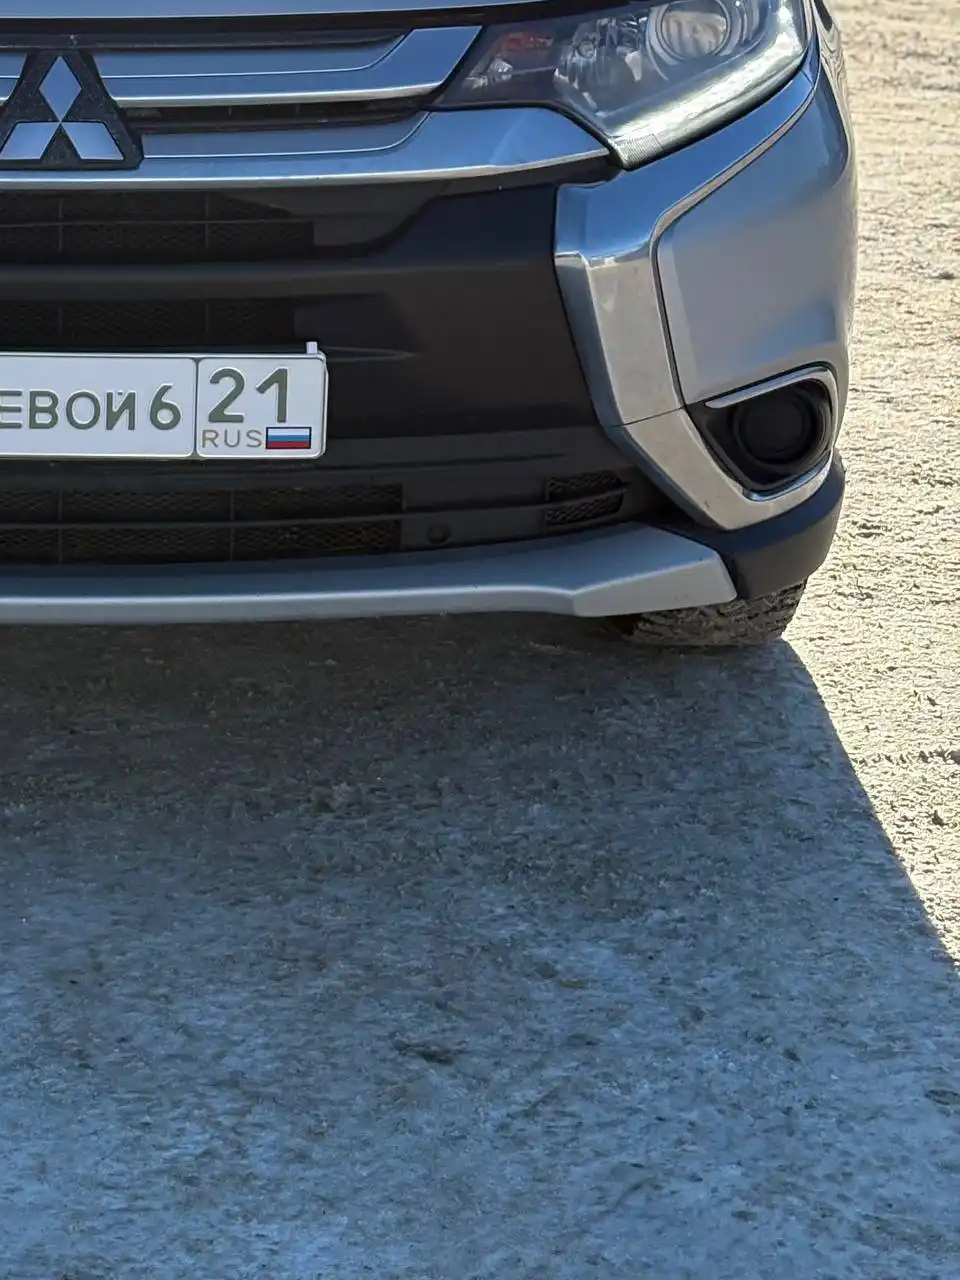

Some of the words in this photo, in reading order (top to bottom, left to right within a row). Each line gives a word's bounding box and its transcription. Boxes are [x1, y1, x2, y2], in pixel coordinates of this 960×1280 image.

[149, 384, 182, 431] 6
[208, 367, 288, 424] 21
[201, 429, 263, 449] RUS
